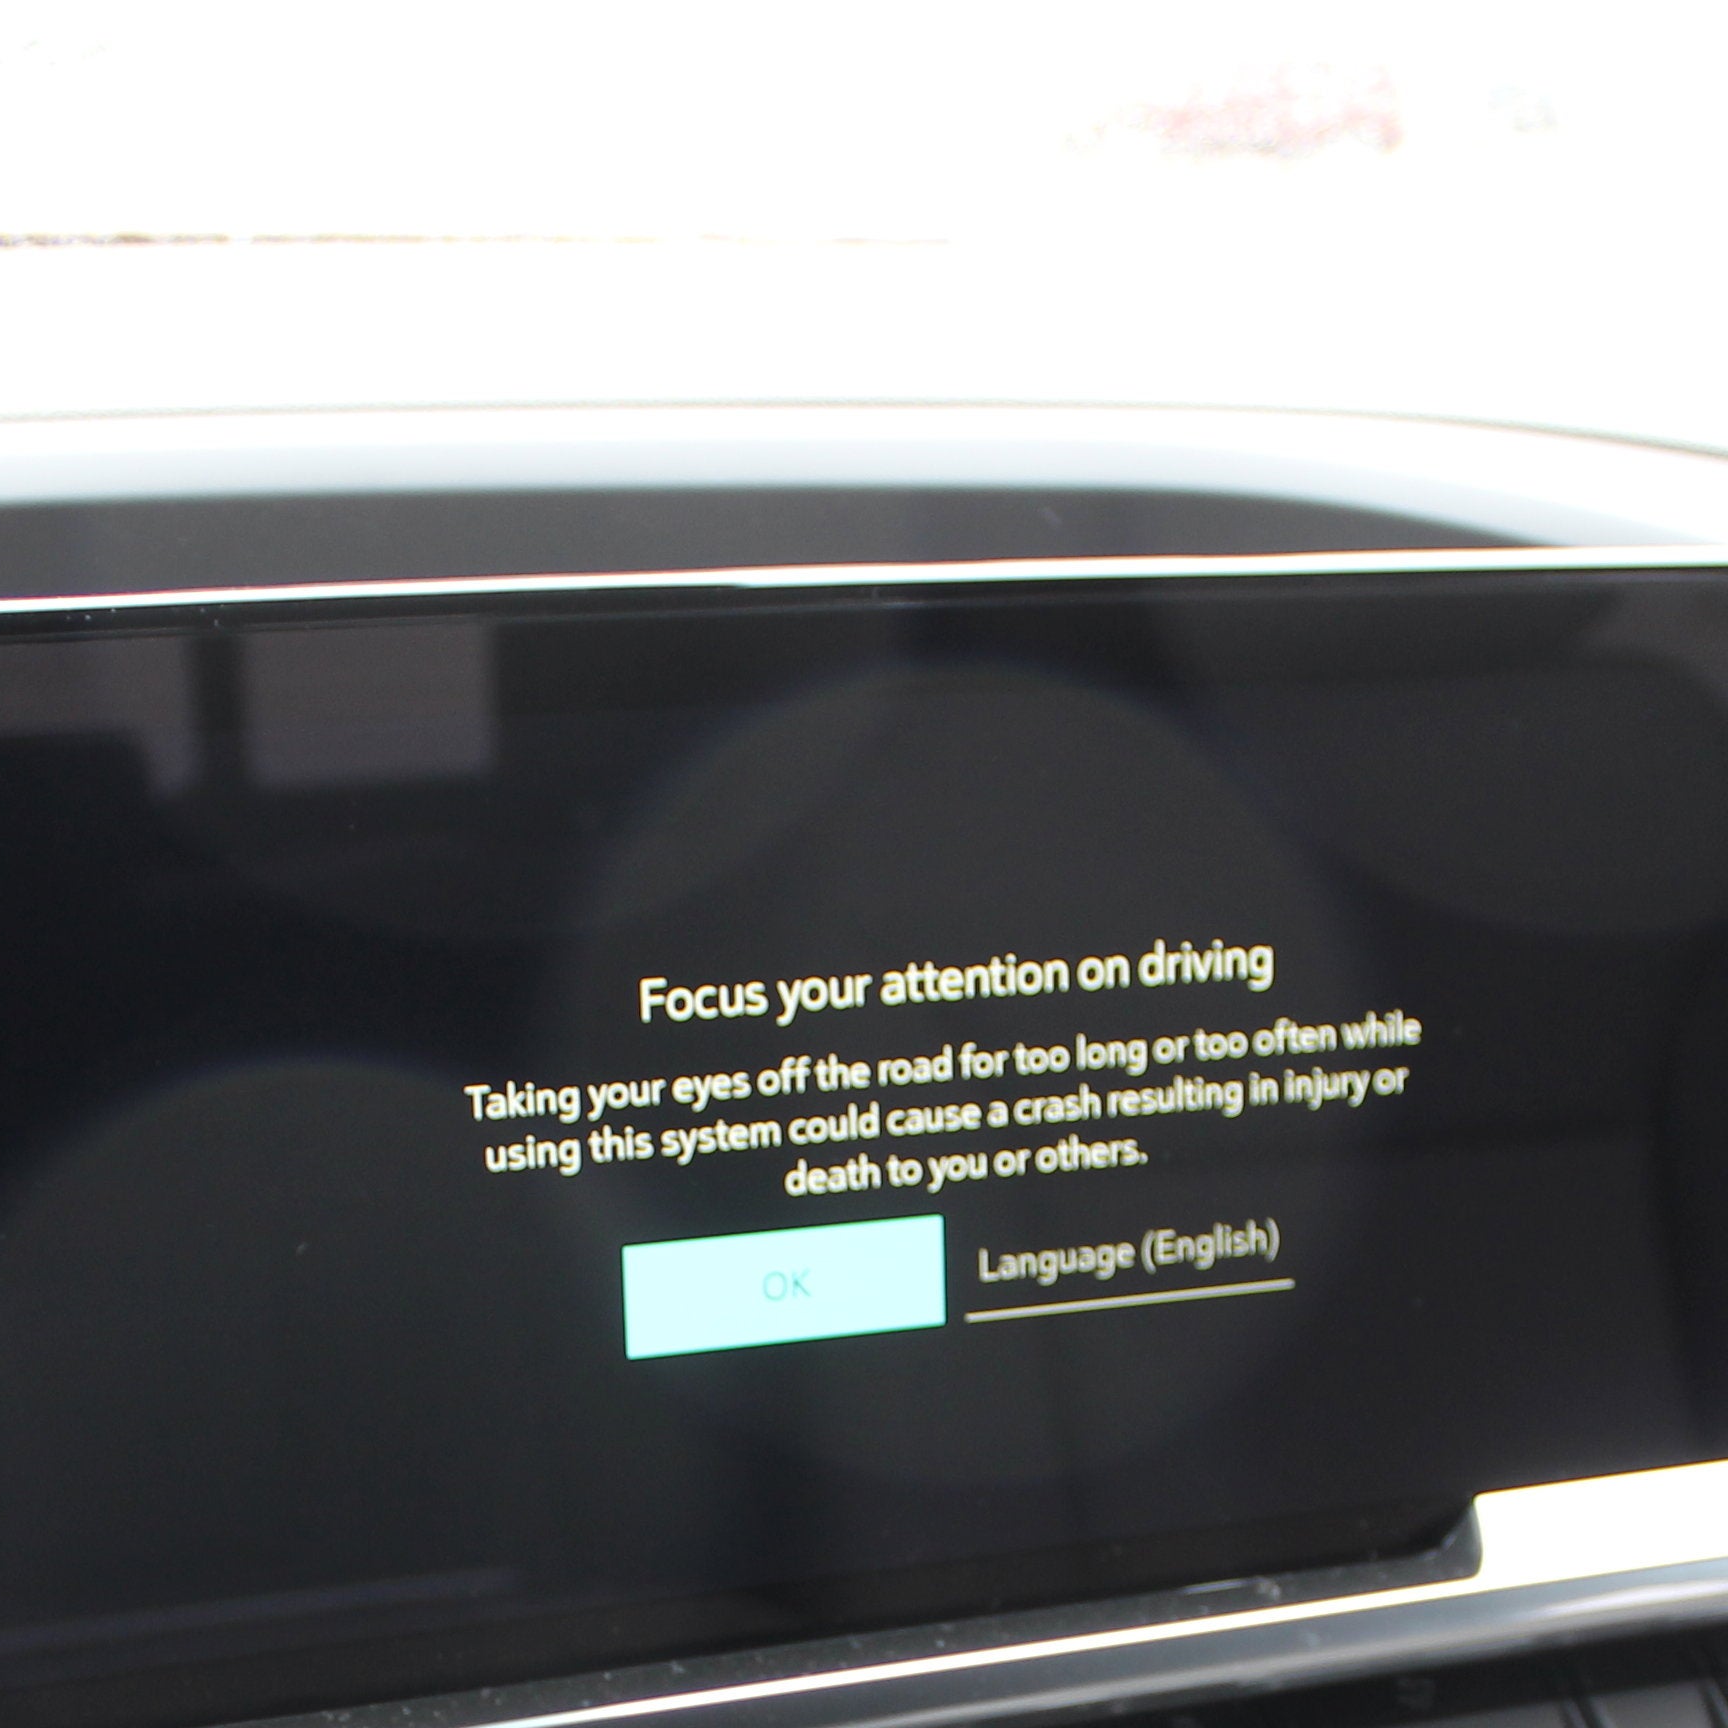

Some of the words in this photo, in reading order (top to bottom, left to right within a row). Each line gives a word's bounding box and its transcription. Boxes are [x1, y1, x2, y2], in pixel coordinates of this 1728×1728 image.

[639, 976, 769, 1023] Focus
[776, 974, 872, 1027] your
[880, 952, 1070, 1006] attention
[1076, 955, 1130, 991] on
[1137, 938, 1274, 992] driving
[463, 1079, 582, 1124] Taking
[587, 1077, 667, 1122] your
[671, 1071, 753, 1113] eyes
[756, 1054, 812, 1096] off
[813, 1052, 872, 1092] the
[877, 1043, 954, 1087] road
[959, 1041, 1010, 1081] for
[1013, 1041, 1072, 1076] too
[1075, 1032, 1148, 1077] long
[1151, 1035, 1190, 1065] or
[1192, 1027, 1249, 1061] too
[1252, 1016, 1338, 1056] often
[1340, 1008, 1423, 1050] while
[484, 1134, 583, 1177] using
[587, 1124, 655, 1164] this
[660, 1118, 783, 1166] system
[787, 1100, 881, 1146] could
[884, 1101, 983, 1137] cause
[986, 1099, 1010, 1129] a
[1013, 1082, 1102, 1127] crash
[1106, 1074, 1245, 1119] resulting
[1248, 1070, 1280, 1107] in
[1282, 1065, 1371, 1112] injury
[1372, 1066, 1411, 1096] or
[783, 1151, 883, 1197] death
[885, 1154, 924, 1188] to
[926, 1152, 989, 1195] you
[992, 1148, 1033, 1178] or
[1034, 1132, 1150, 1175] others.
[762, 1269, 813, 1303] OK
[977, 1239, 1137, 1287] Language
[1141, 1216, 1281, 1275] (English)
